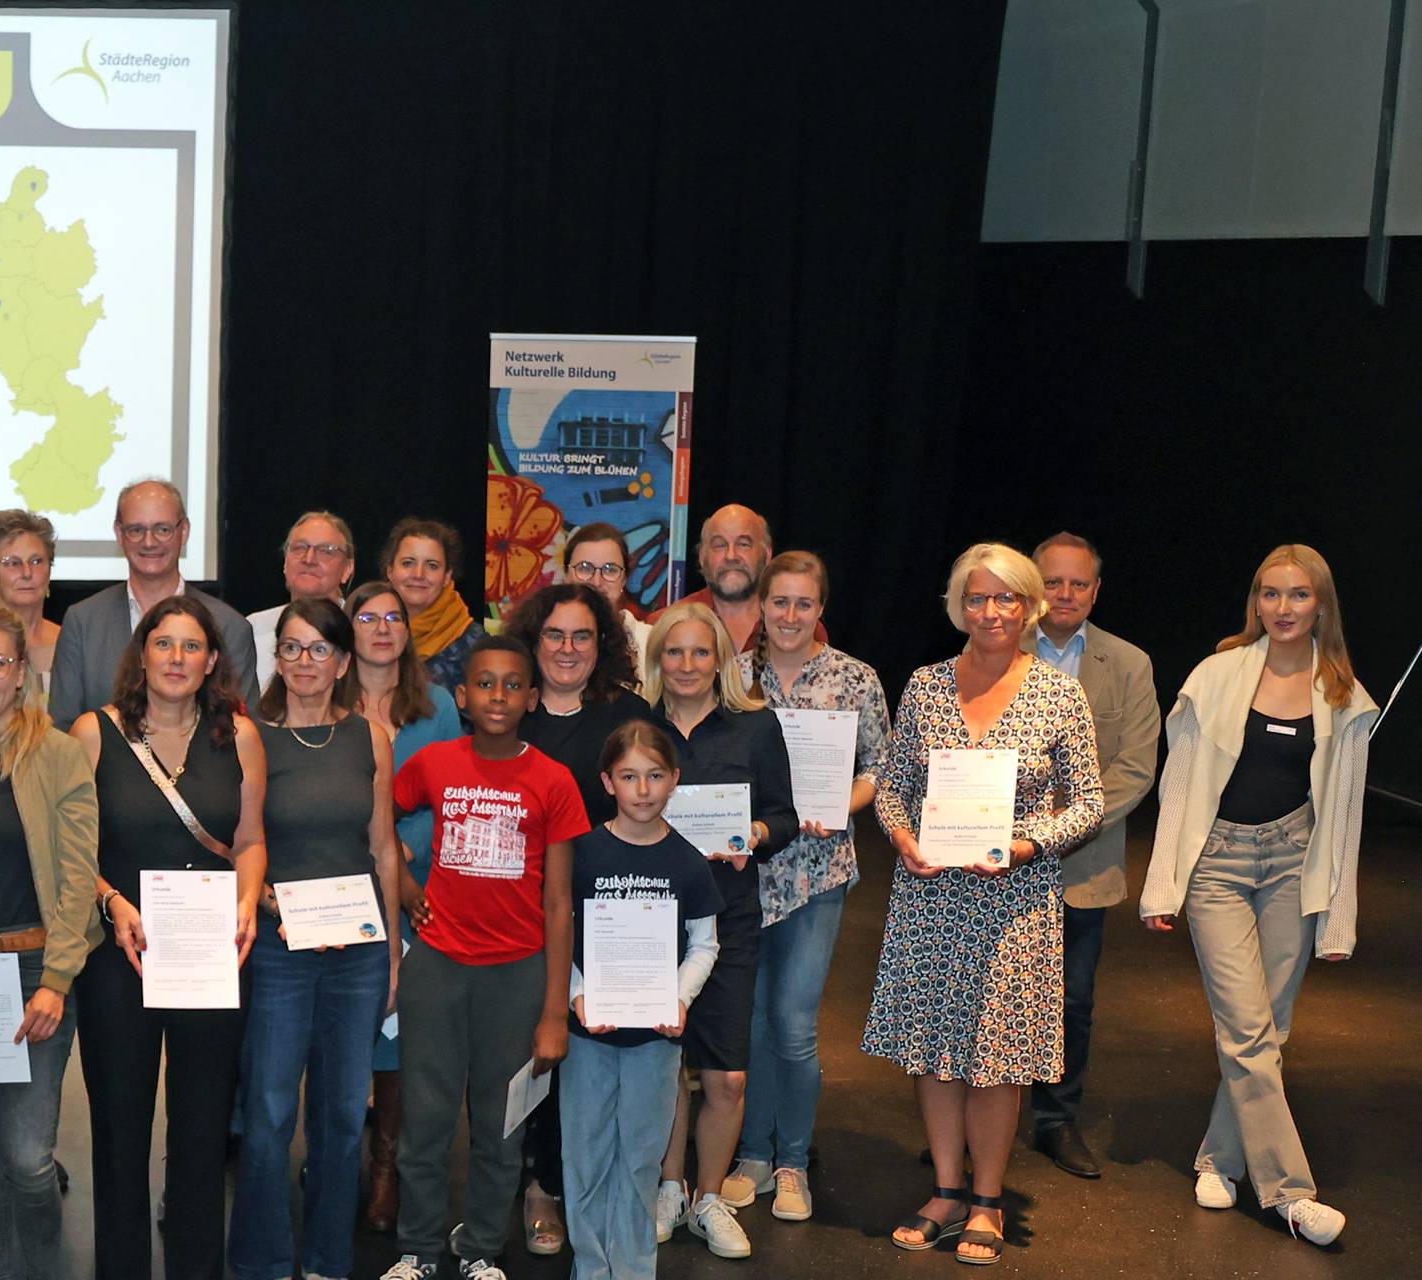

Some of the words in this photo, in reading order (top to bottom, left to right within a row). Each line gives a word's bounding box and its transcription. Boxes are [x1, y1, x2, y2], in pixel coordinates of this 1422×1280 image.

[98, 53, 190, 70] StädteRegion
[111, 70, 161, 83] Aachen
[505, 350, 564, 362] Netzwerk
[504, 365, 565, 378] Kulturelle
[568, 367, 617, 381] Bildung
[519, 452, 561, 462] KULTUR
[563, 454, 606, 464] BRINGT
[518, 463, 565, 474] BILDUNG
[566, 464, 592, 475] ZUM
[594, 464, 638, 476] BLÜHEN
[442, 800, 468, 819] KGS
